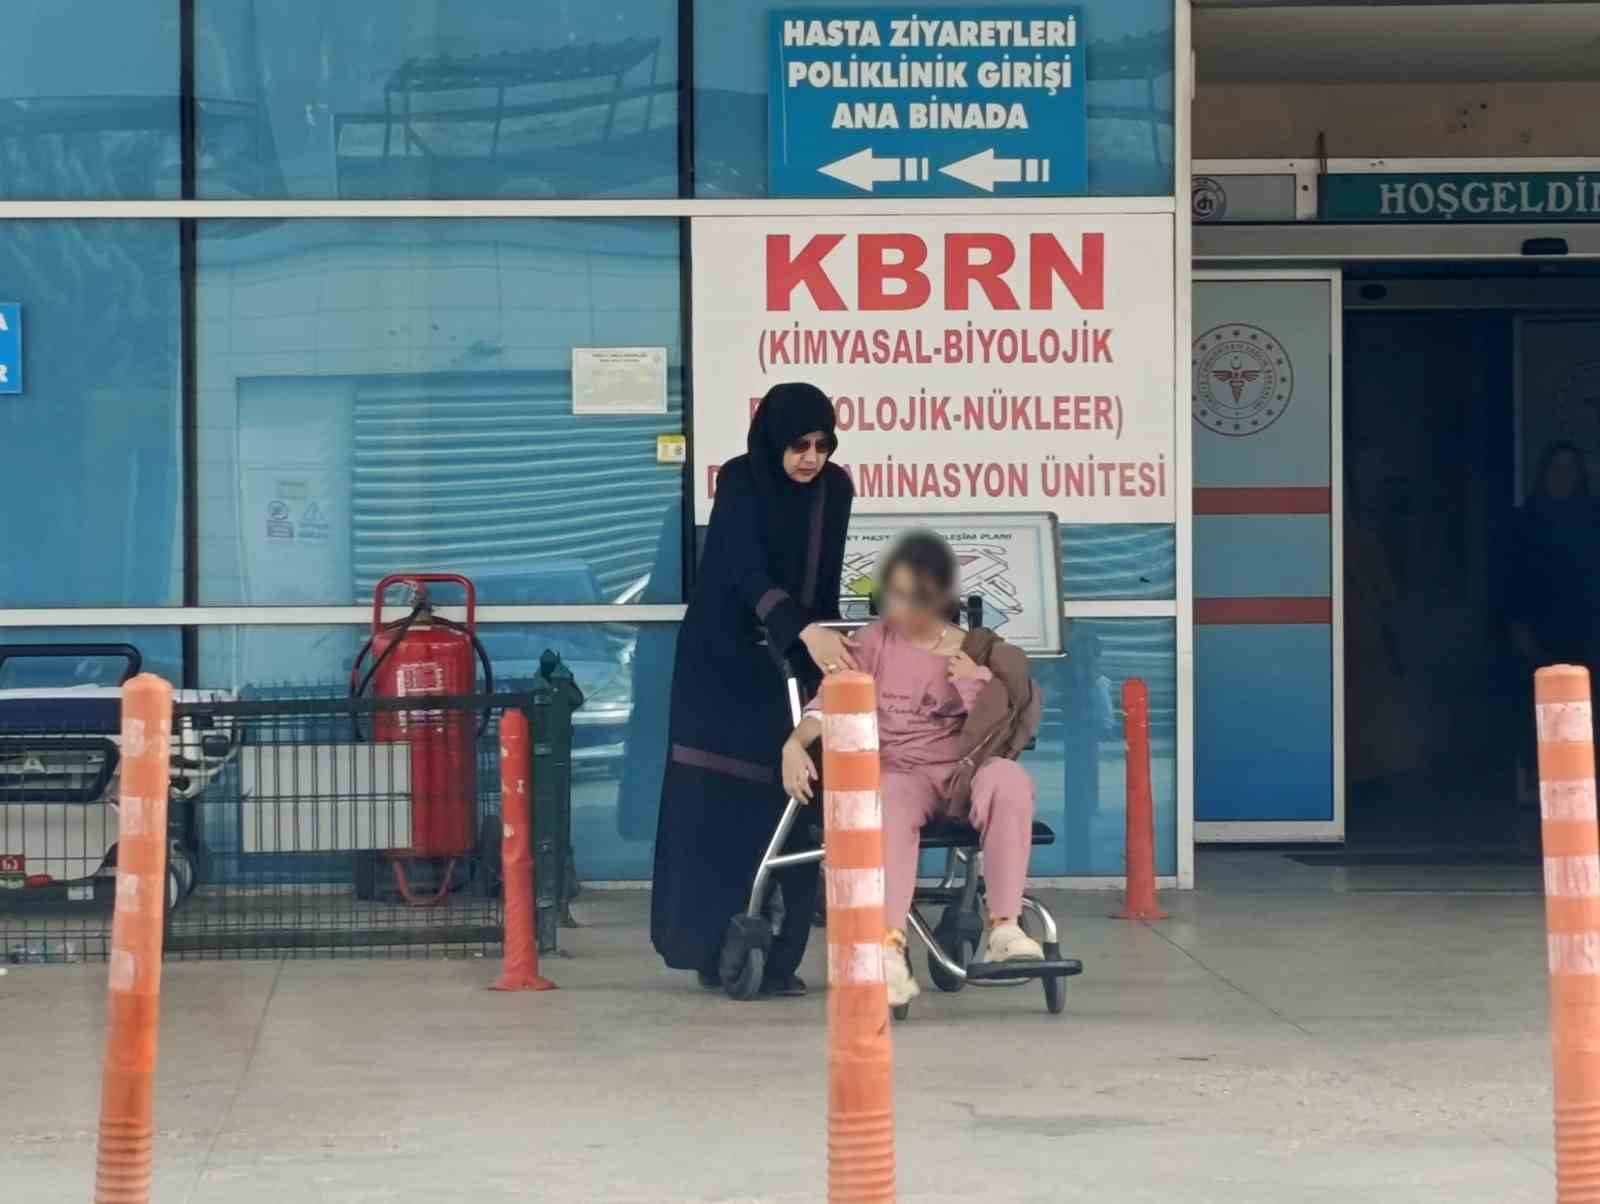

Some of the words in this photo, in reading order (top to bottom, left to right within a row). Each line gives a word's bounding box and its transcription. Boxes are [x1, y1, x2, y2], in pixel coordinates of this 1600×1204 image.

[784, 20, 880, 47] HASTA
[890, 14, 1076, 47] ZİYARETLERİ
[788, 54, 968, 88] POLİKLİNİK
[977, 54, 1072, 96] GİRİŞİ
[831, 102, 899, 129] ANA
[909, 95, 1028, 129] BİNADA
[765, 232, 1105, 312] KBRN
[758, 321, 1113, 374] (KİMYASAL-BİYOLOJİK
[750, 388, 1123, 440] OLOJİK-NÜKLEER)
[1041, 454, 1166, 498] ÜNİTESİ
